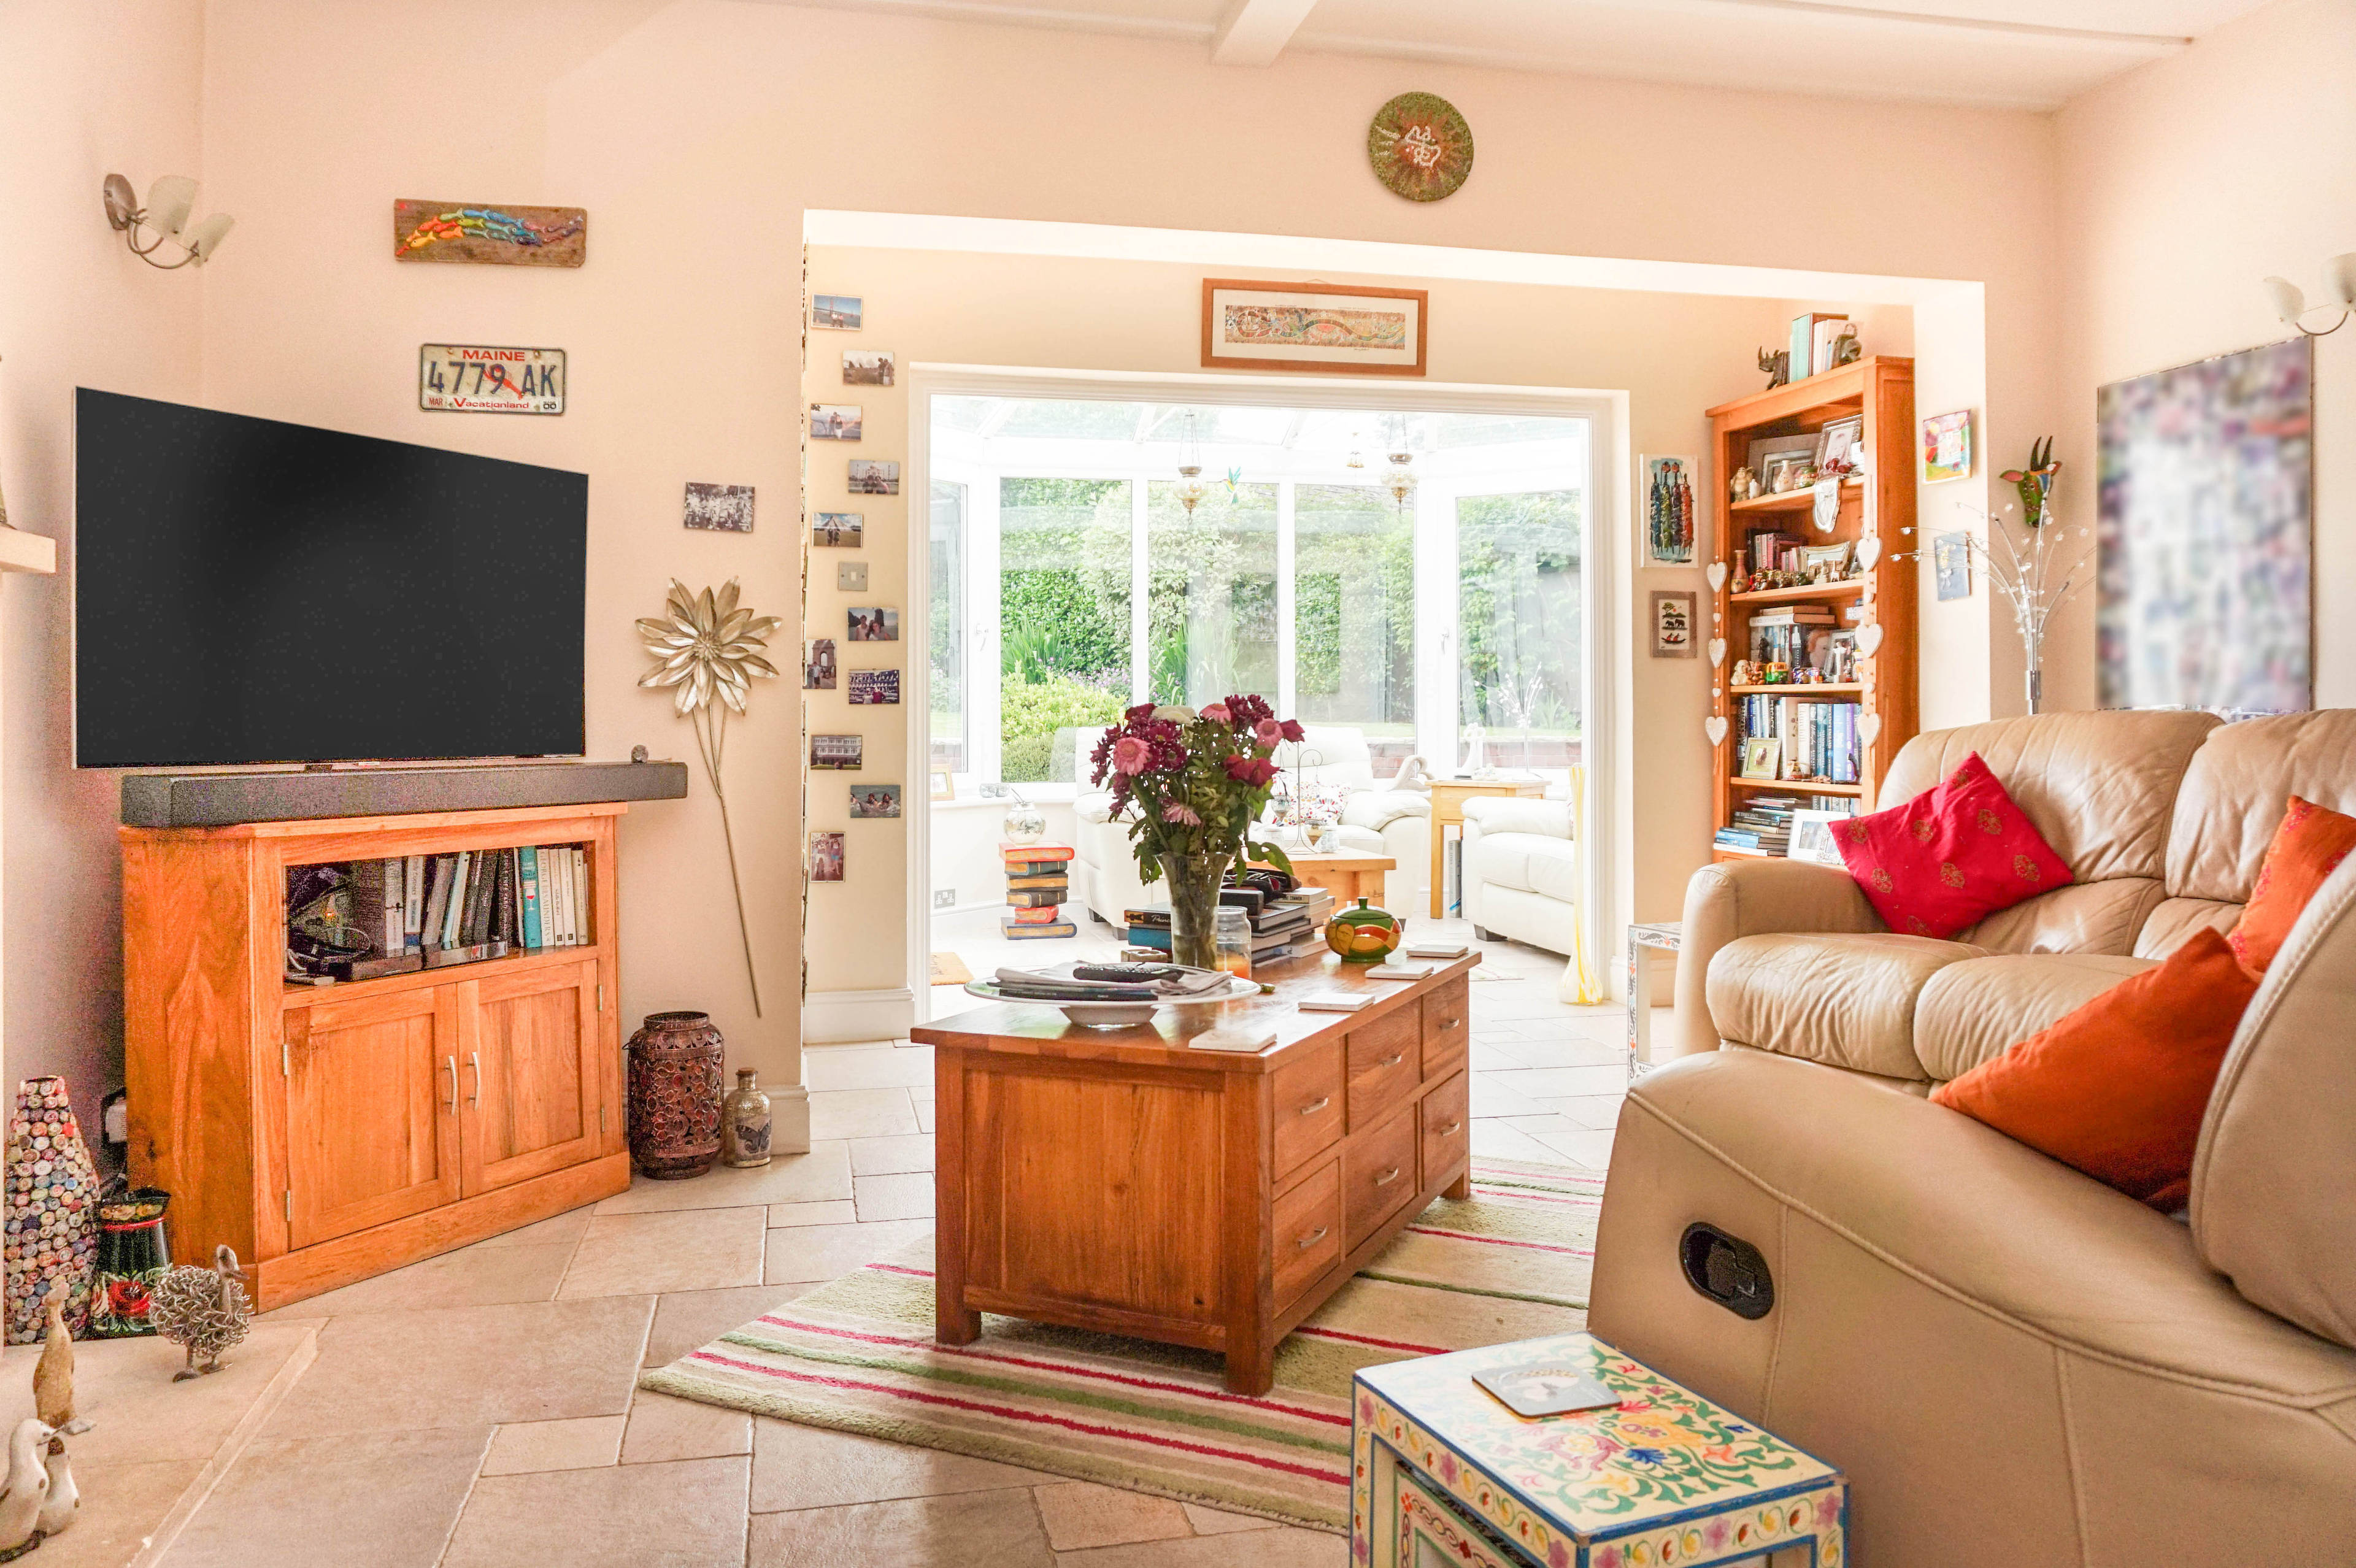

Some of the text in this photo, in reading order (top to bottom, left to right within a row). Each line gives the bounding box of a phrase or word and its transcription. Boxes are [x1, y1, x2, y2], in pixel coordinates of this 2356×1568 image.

[462, 350, 526, 362] MAINE
[428, 361, 556, 397] 4779 AK
[453, 398, 529, 409] Vacationland
[1151, 914, 1171, 923] Princ
